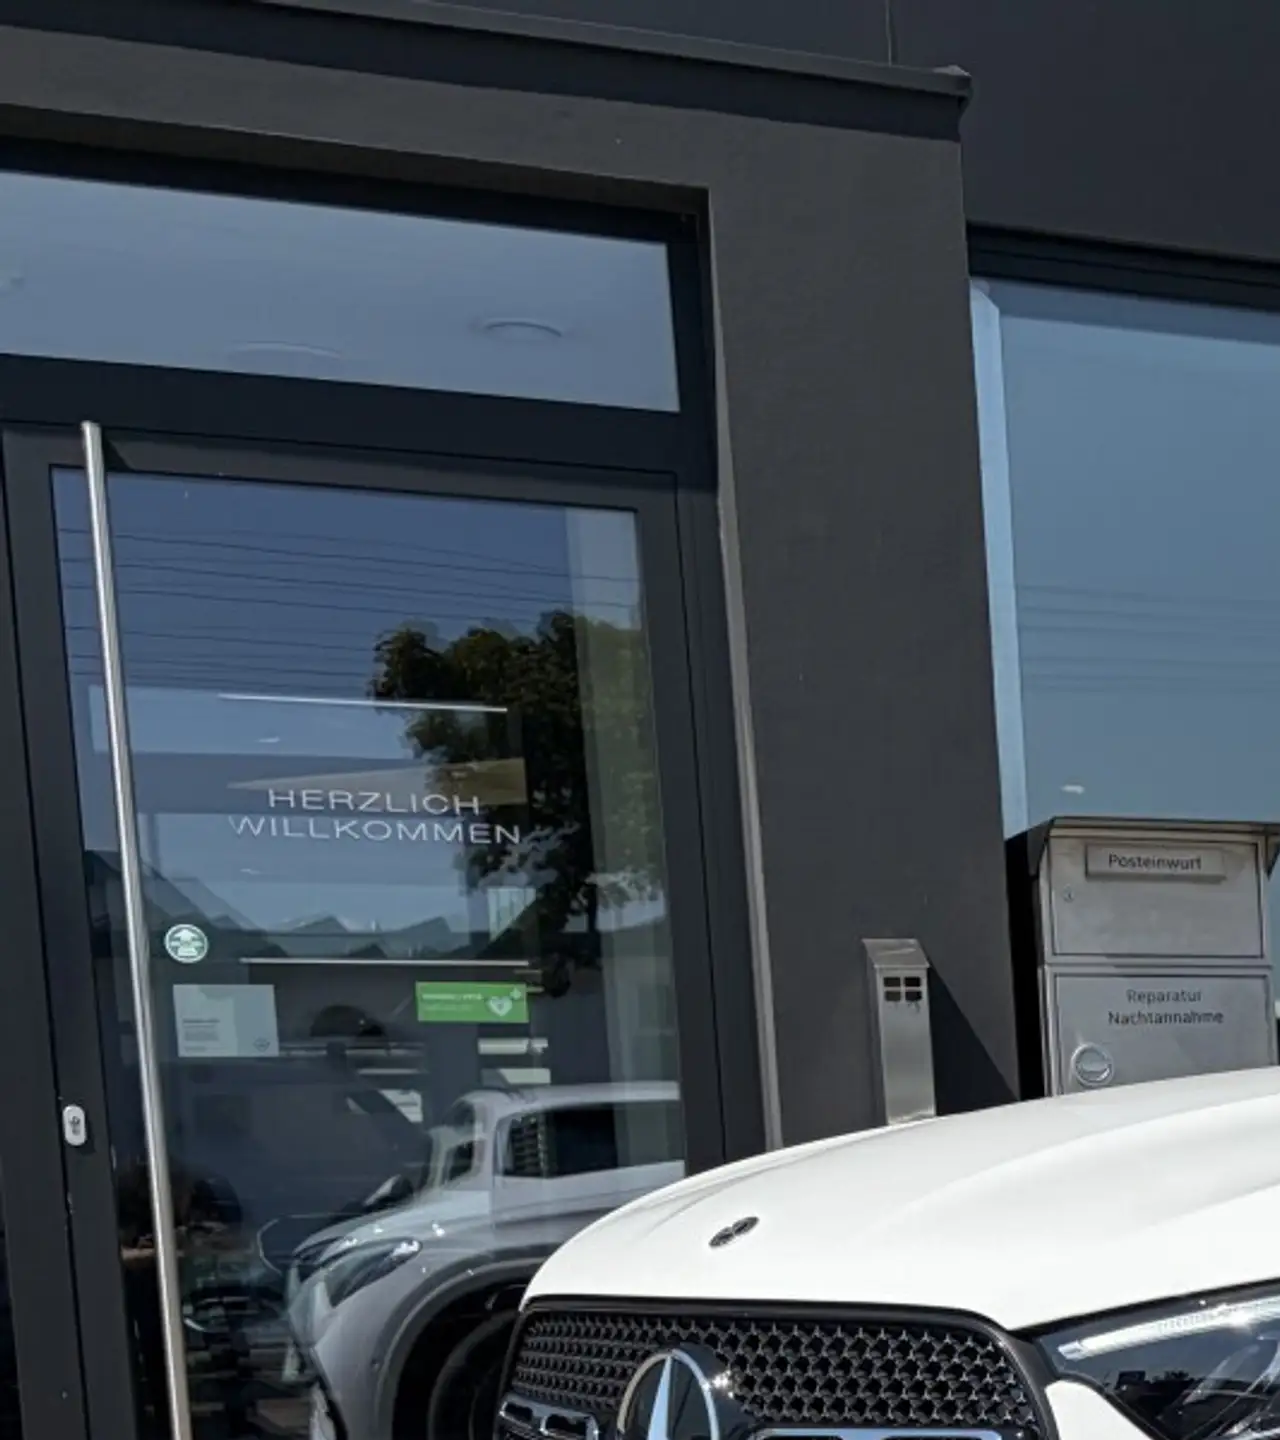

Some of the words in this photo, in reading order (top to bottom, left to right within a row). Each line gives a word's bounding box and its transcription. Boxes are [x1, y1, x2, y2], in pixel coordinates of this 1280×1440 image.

[268, 788, 480, 816] HERZLICH
[228, 815, 519, 844] WILLKOMMEN
[1108, 852, 1202, 871] Posteinwurf
[1126, 988, 1203, 1006] Reparatur
[1107, 1010, 1224, 1026] Nachtannahme
